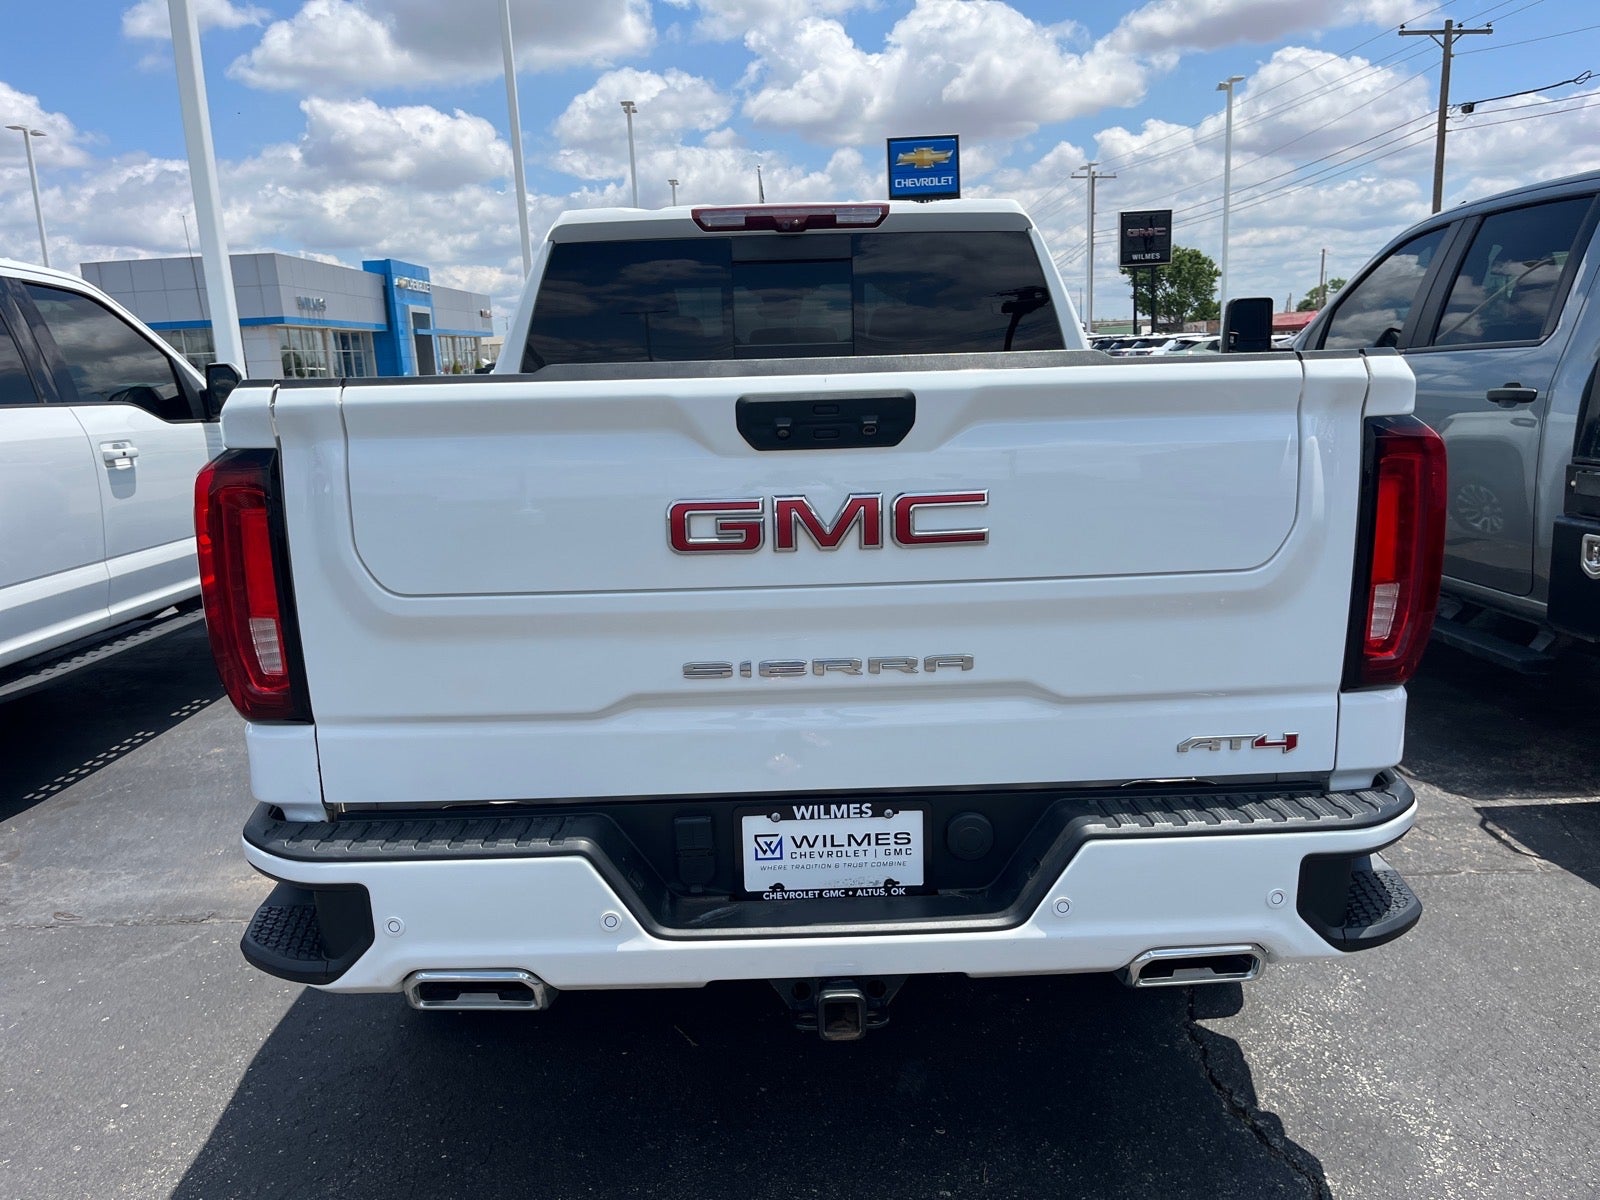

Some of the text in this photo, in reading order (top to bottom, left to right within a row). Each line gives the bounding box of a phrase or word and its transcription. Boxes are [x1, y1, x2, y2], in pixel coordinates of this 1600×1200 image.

[894, 176, 954, 188] CHEVROLET
[1126, 227, 1167, 237] GMC
[1131, 252, 1161, 261] WILMES
[666, 489, 989, 555] GMC
[682, 653, 974, 679] SIERRA
[1177, 732, 1299, 753] AT4
[792, 803, 873, 820] WILMES
[790, 831, 912, 849] WILMES
[790, 847, 913, 859] CHEVROLET GMC
[843, 861, 868, 869] TRUST
[763, 887, 906, 900] CHEVROLET GMC ALTUS, OK
